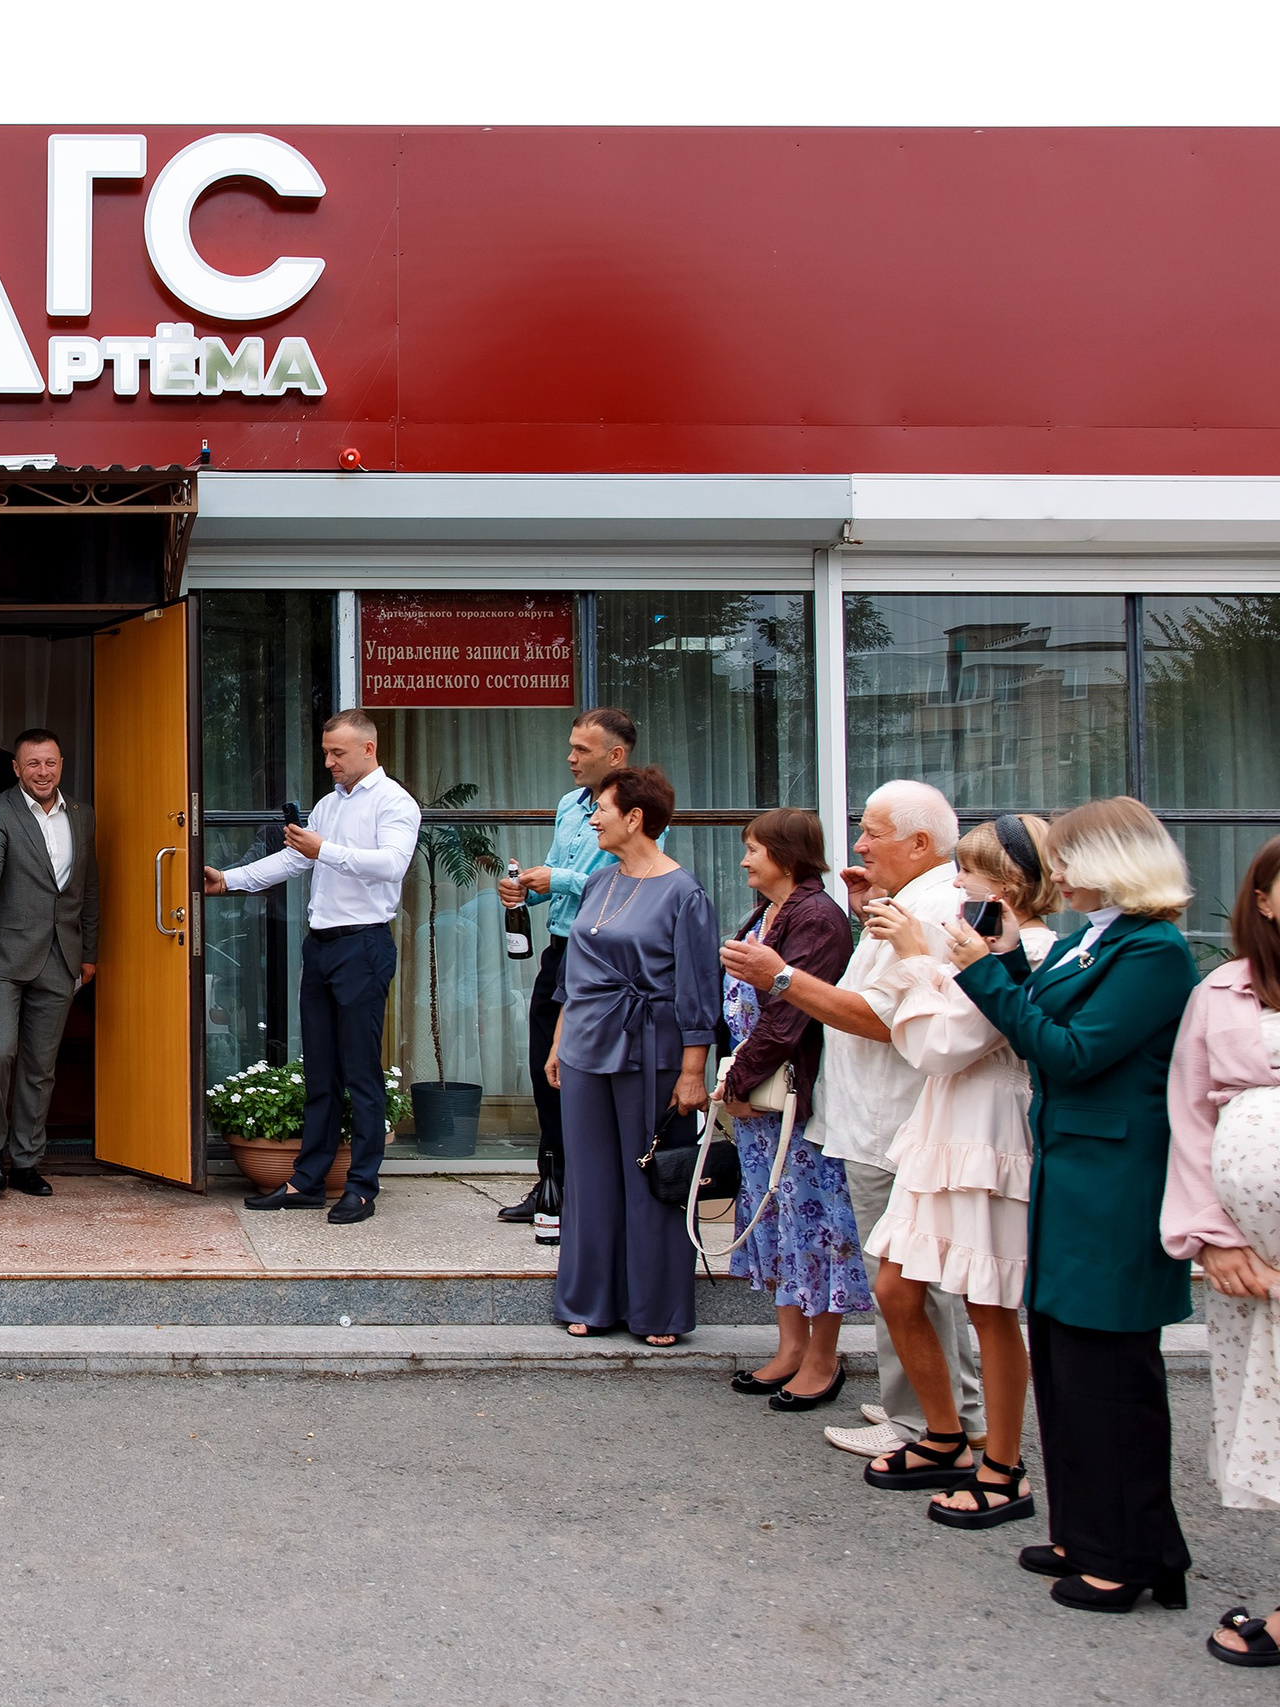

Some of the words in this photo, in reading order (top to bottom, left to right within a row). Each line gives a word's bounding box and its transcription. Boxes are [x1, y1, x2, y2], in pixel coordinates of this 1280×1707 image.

[456, 610, 515, 620] городского
[518, 611, 555, 620] округа
[365, 640, 459, 664] Управление
[465, 645, 519, 660] записи
[526, 645, 569, 660] актов
[365, 674, 479, 693] гражданского
[485, 674, 569, 688] состояния
